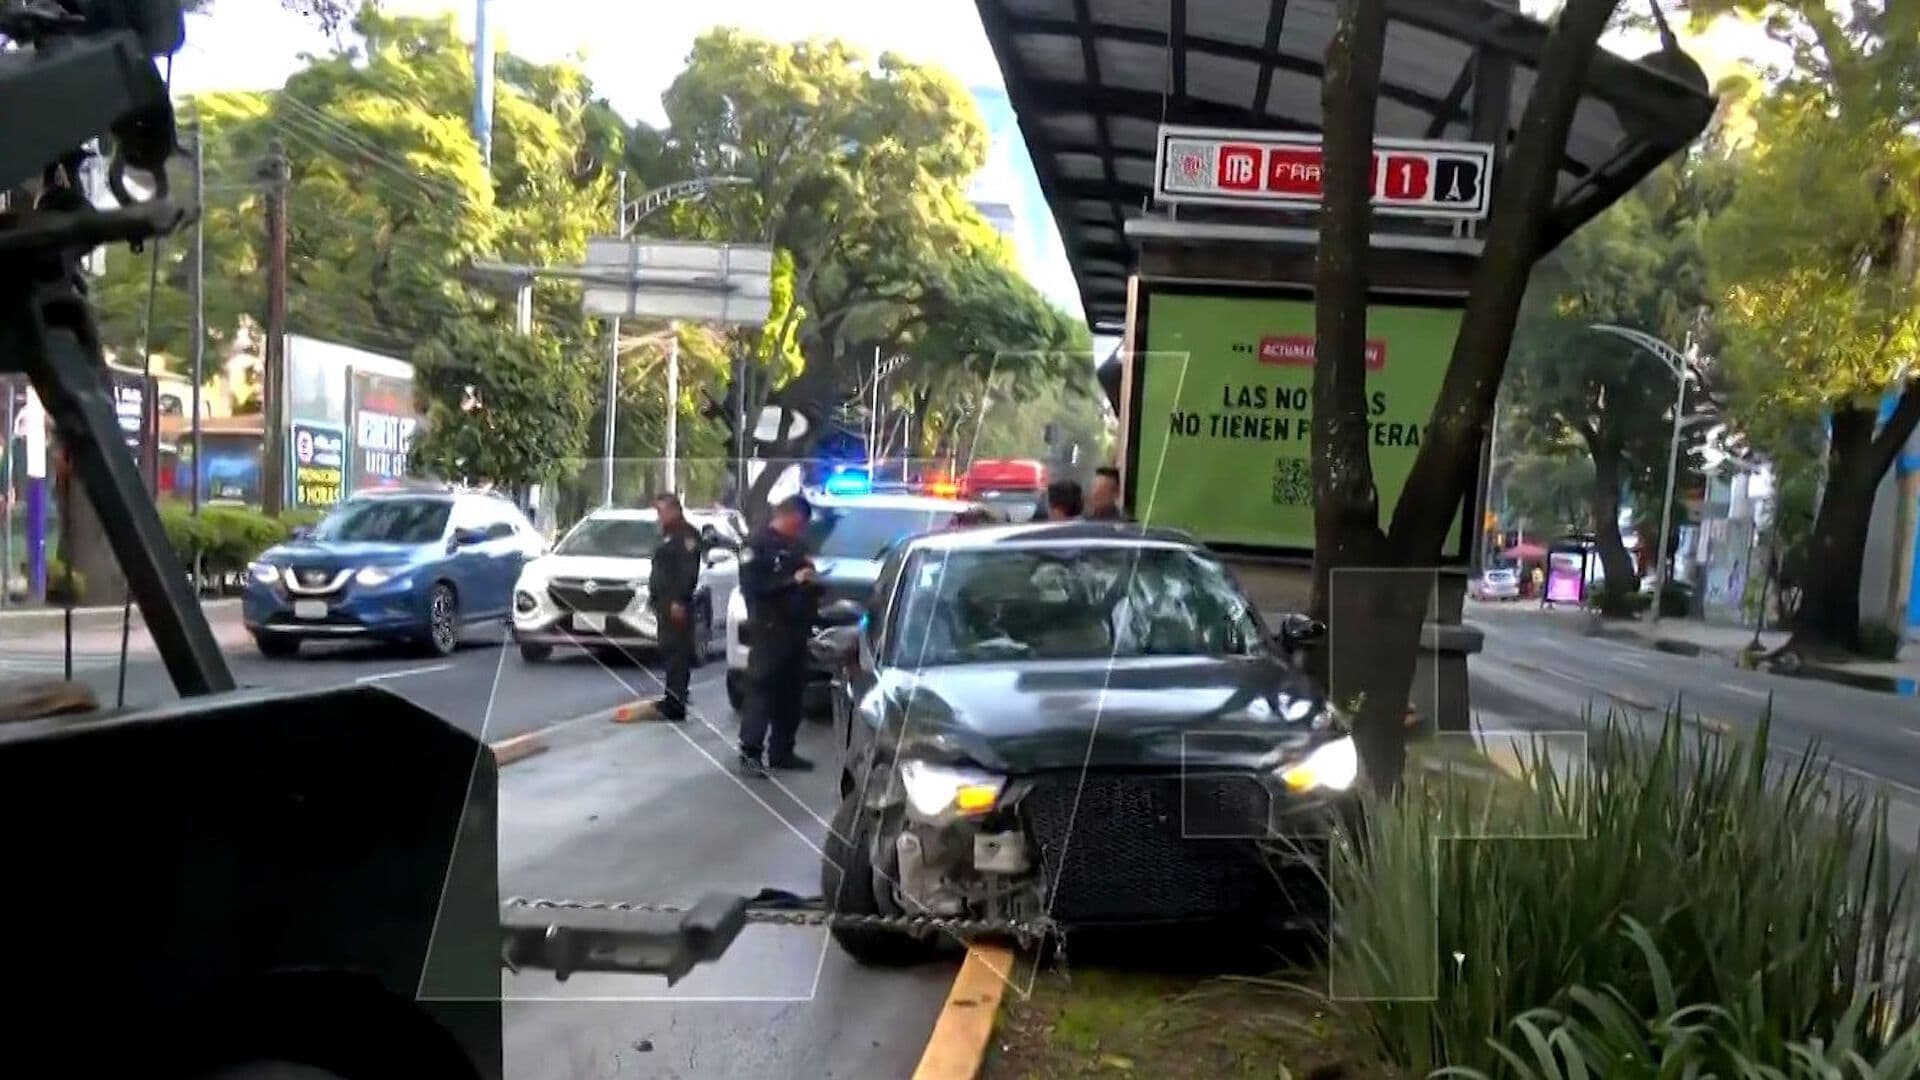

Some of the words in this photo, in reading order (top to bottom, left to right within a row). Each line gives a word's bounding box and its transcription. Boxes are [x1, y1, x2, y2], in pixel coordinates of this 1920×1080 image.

[1401, 163, 1411, 194] 1
[1223, 385, 1267, 409] LAS
[1169, 411, 1201, 436] NO
[1208, 414, 1289, 440] TIENEN
